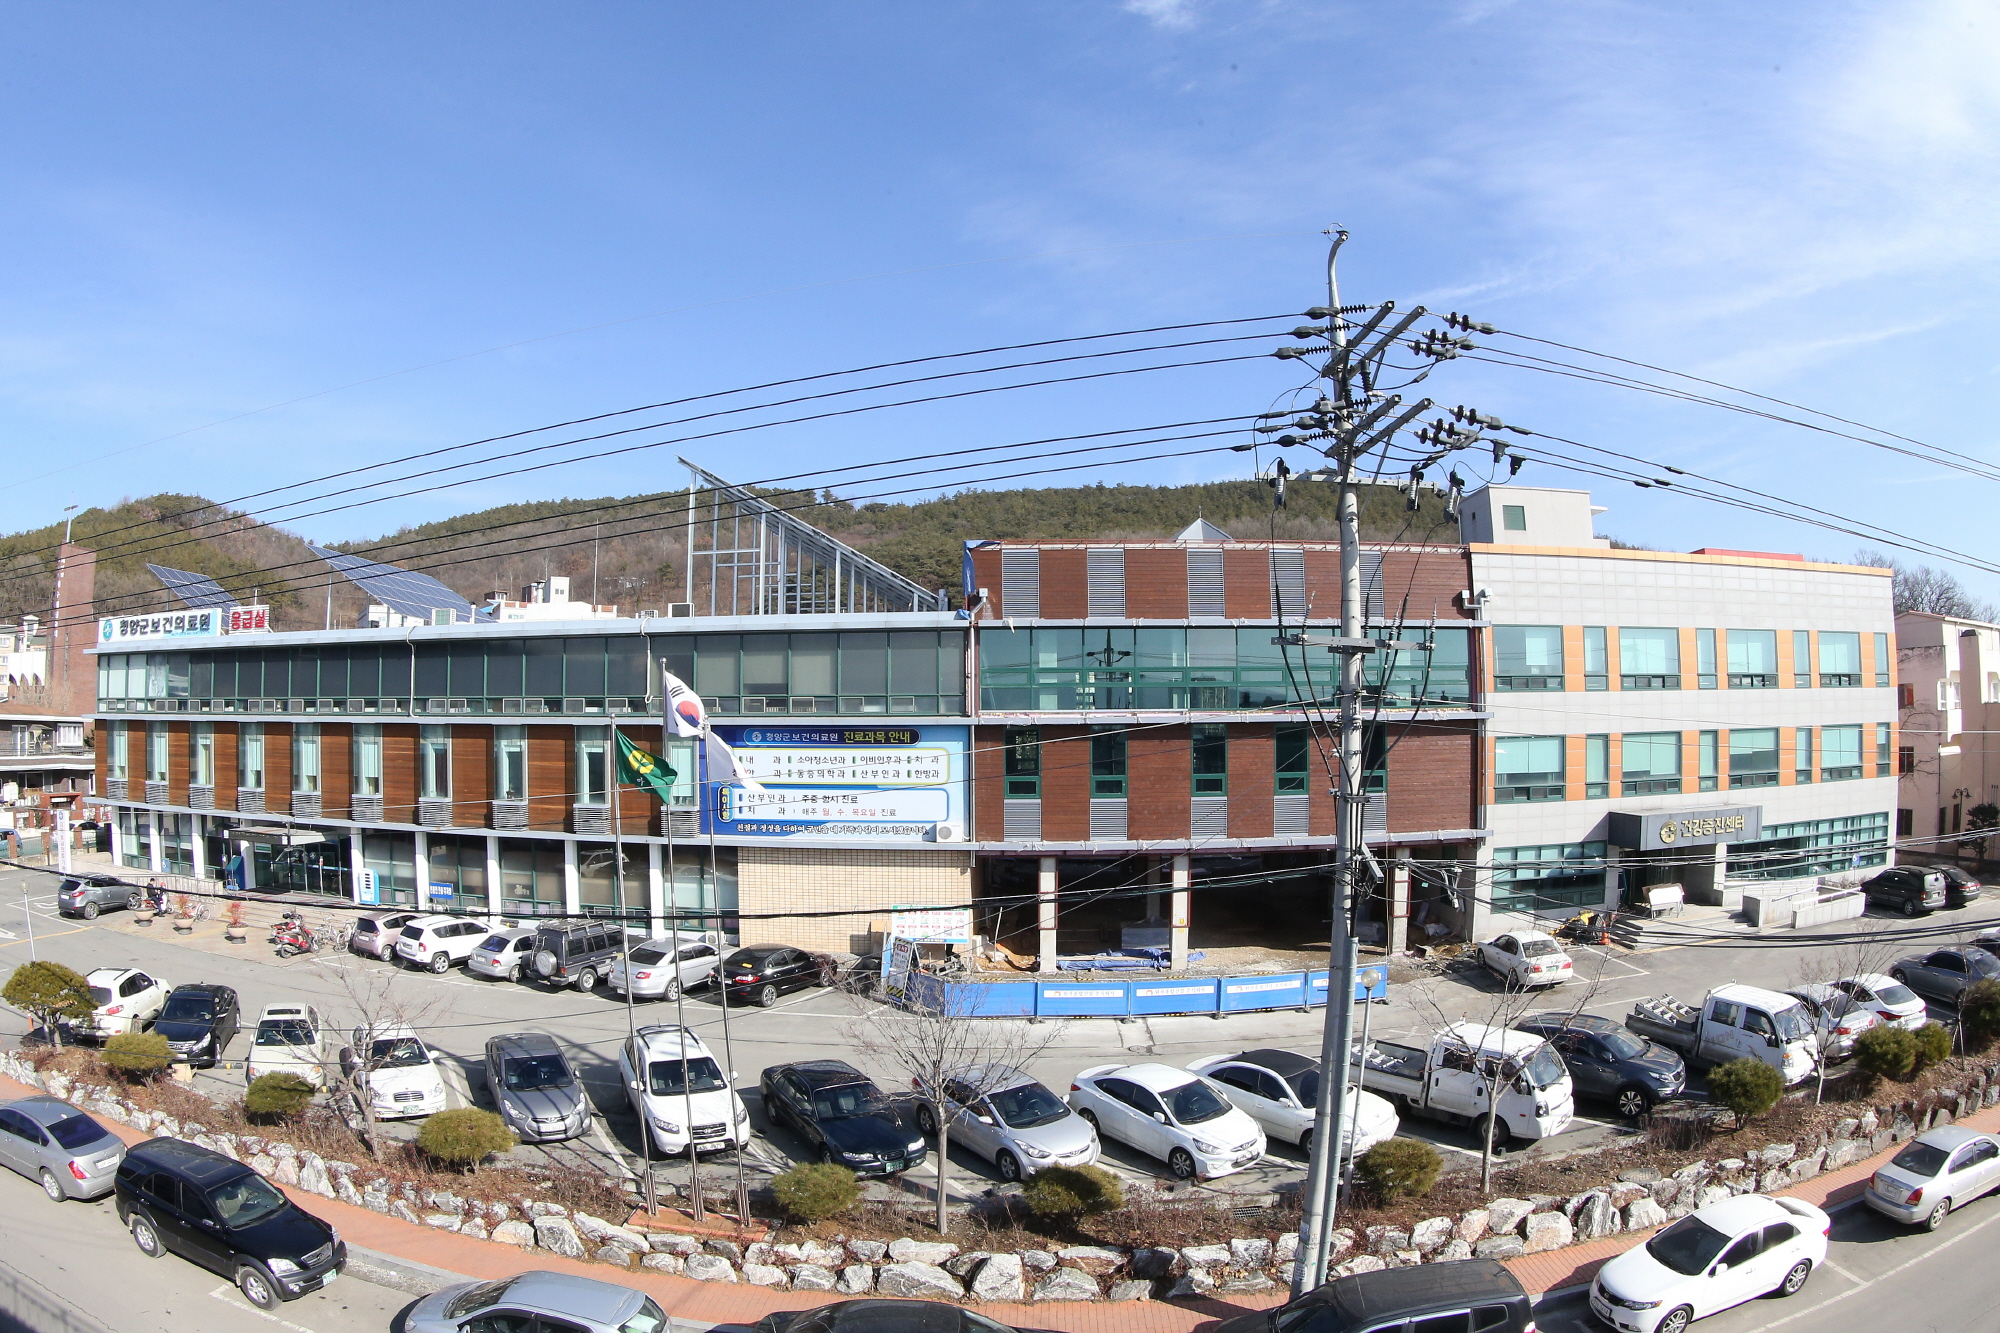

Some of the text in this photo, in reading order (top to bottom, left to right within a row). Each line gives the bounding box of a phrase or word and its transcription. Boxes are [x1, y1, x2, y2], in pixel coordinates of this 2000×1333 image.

[119, 612, 211, 637] 청양군보건의료원
[231, 610, 266, 630] 응급실
[765, 731, 910, 743] 청양군보건의료원 진료과목 안내
[797, 755, 846, 764] 소아청소년과
[860, 755, 901, 764] 이비인후과
[860, 769, 901, 779] 산부인과
[914, 769, 940, 779] 한방과
[802, 794, 819, 804] 주중
[841, 795, 859, 804] 진료
[801, 808, 818, 816] 매주
[851, 808, 876, 817] 목요일
[880, 808, 897, 817] 진료
[736, 823, 758, 833] 친절과
[759, 824, 781, 833] 정성을
[782, 825, 805, 834] 다하여
[806, 825, 830, 835] 군민을
[1680, 814, 1745, 838] 건강증진센터
